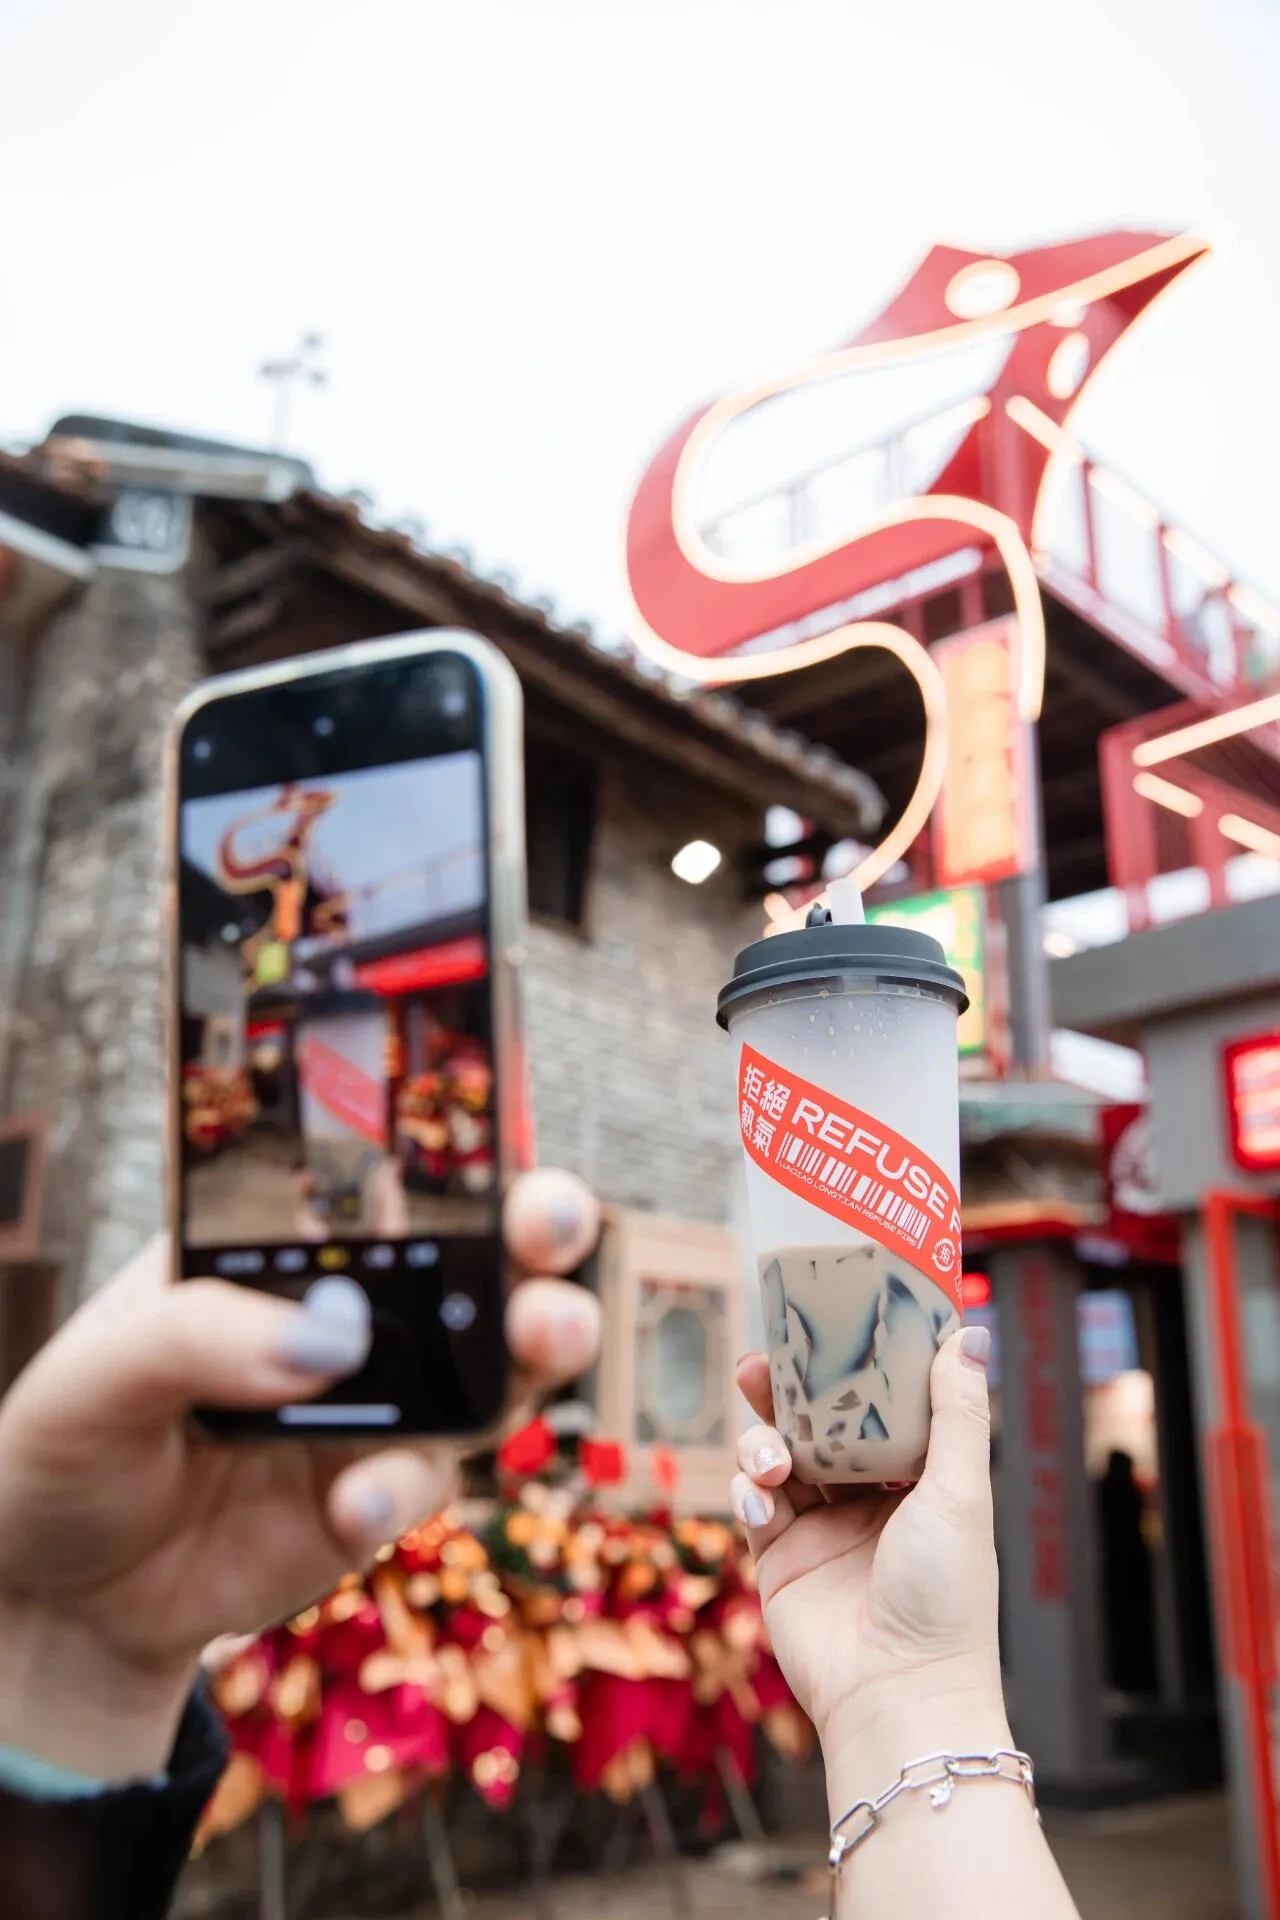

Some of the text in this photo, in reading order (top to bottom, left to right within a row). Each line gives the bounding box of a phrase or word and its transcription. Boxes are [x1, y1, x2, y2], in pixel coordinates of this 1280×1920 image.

[743, 1063, 791, 1121] 拒絕
[792, 1097, 949, 1220] REFUSE
[779, 1160, 919, 1248] LUNJIAO LONGTIAN REFUSE FIRE
